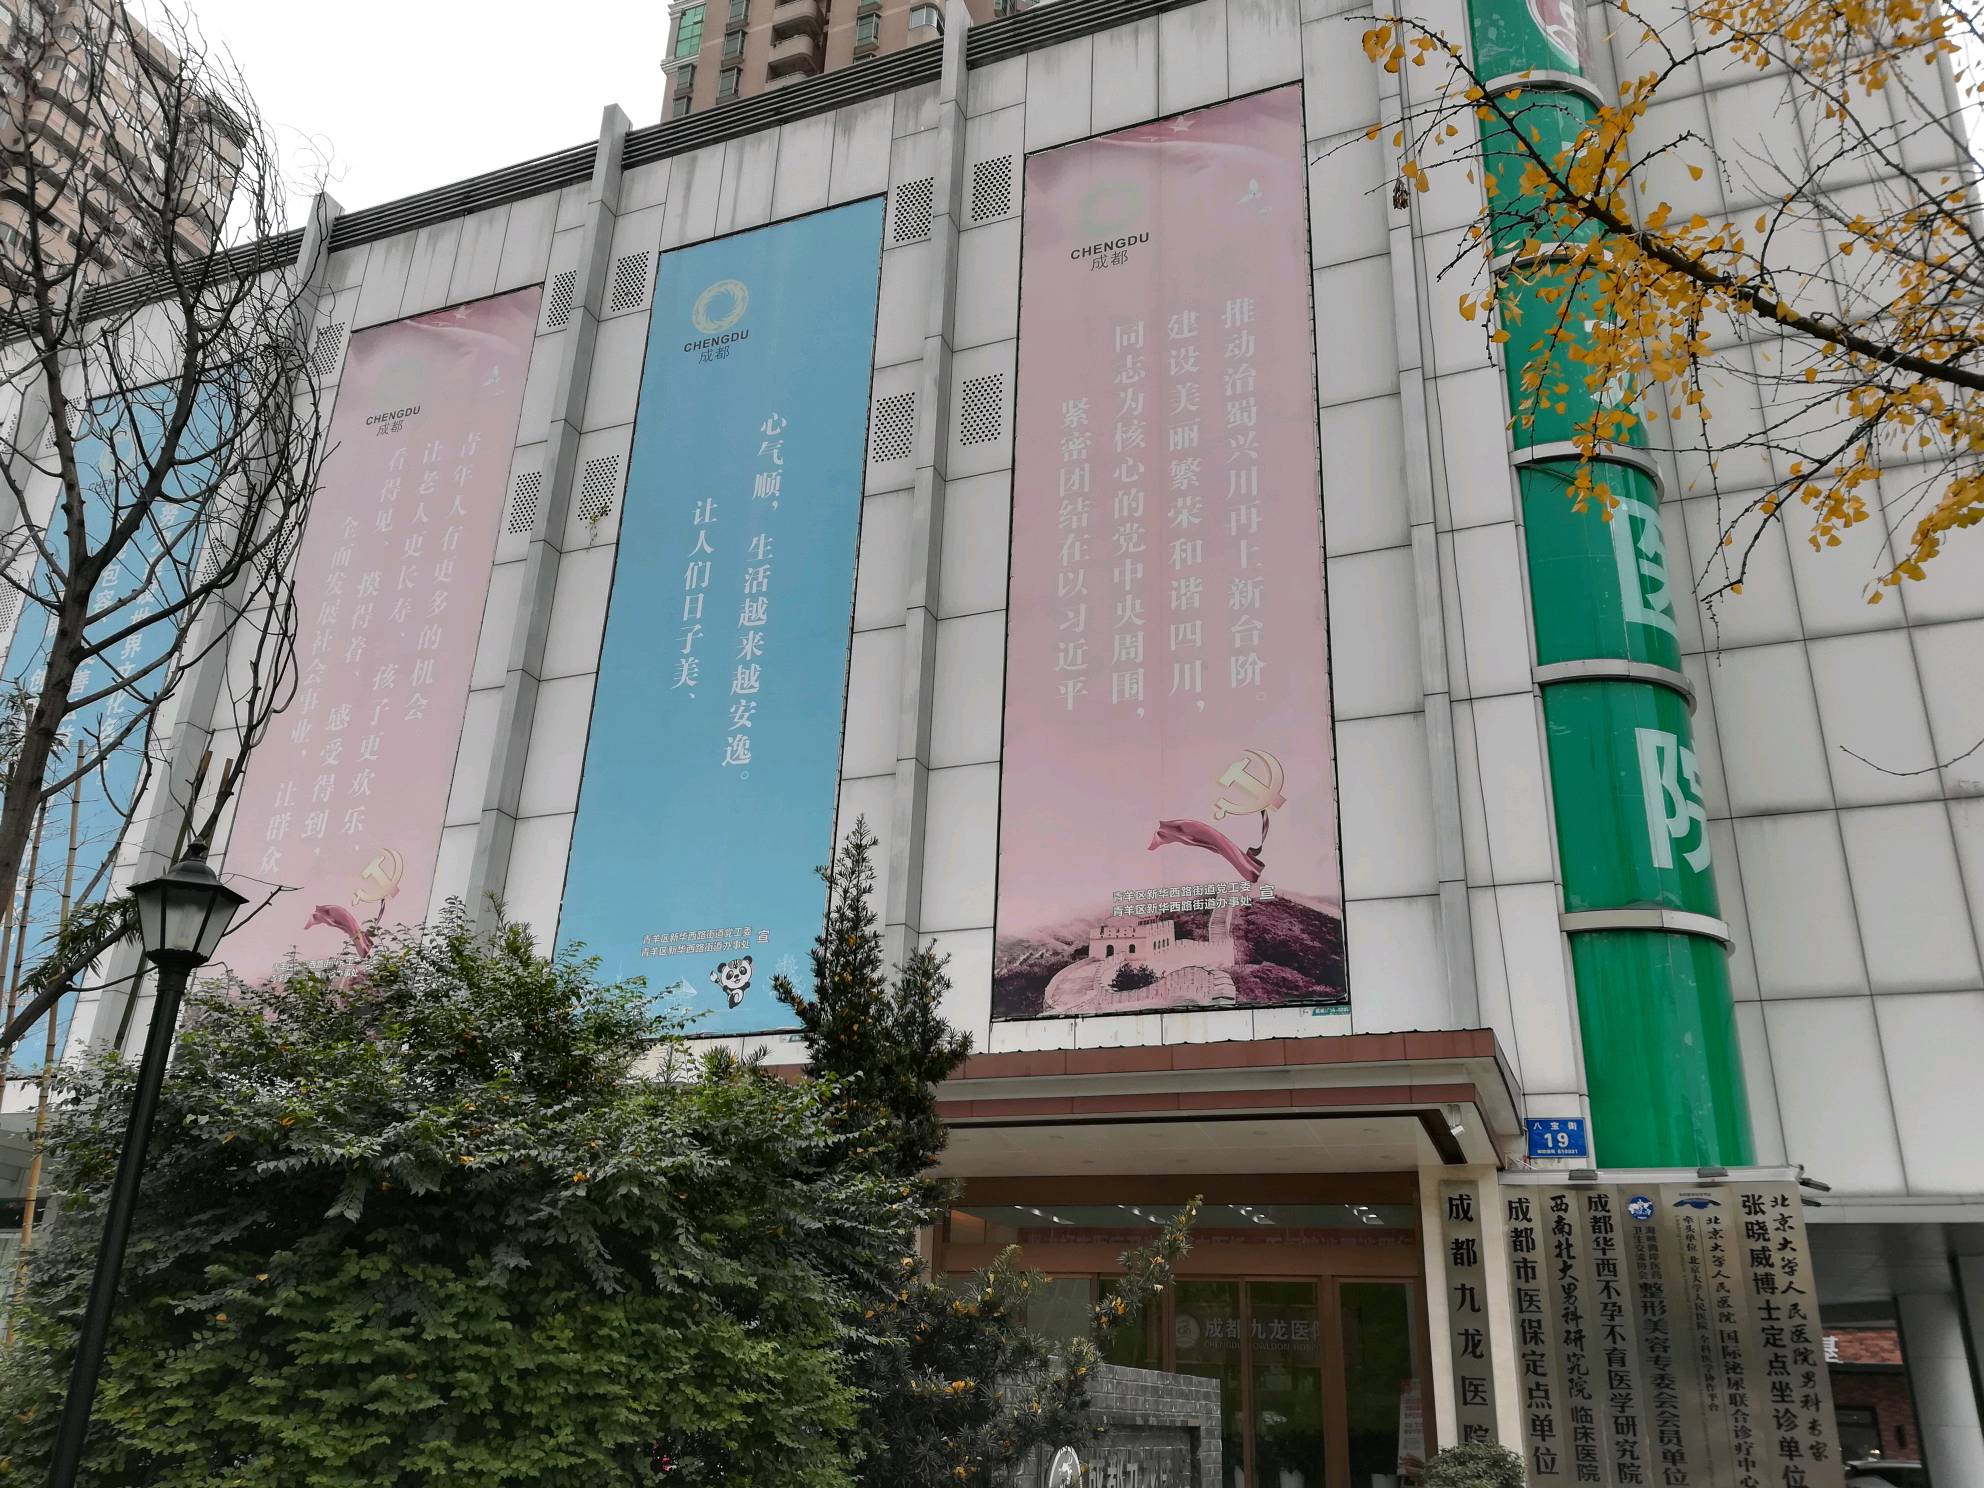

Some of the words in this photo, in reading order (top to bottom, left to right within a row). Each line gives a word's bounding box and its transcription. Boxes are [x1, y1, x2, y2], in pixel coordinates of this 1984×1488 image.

[1070, 231, 1149, 260] CHENGDU
[1091, 249, 1129, 272] 成都
[682, 328, 750, 354] CHENGDU
[698, 345, 731, 366] 成都
[366, 403, 422, 428] CHENGDU
[375, 418, 405, 439] 成都
[1053, 397, 1094, 713] 紧密团结在以习近平
[1112, 880, 1251, 903] 青羊区新华西路街道党工委
[1259, 883, 1275, 902] 宣
[1112, 895, 1253, 917] 青羊区新华西路街道办事处
[756, 929, 770, 944] 宣
[1543, 1132, 1569, 1148] 19
[1447, 1193, 1490, 1444] 成都九龙医院
[1769, 1195, 1830, 1463] 北京大学人民医院男科专家
[1507, 1197, 1561, 1476] 成都市医保定点单位
[1587, 1193, 1644, 1486] 成都华西不孕不育医学研究院
[1740, 1193, 1808, 1488] 张晓威博士定点坐诊单位
[1639, 1282, 1690, 1487] 整形美容专委会会员单位
